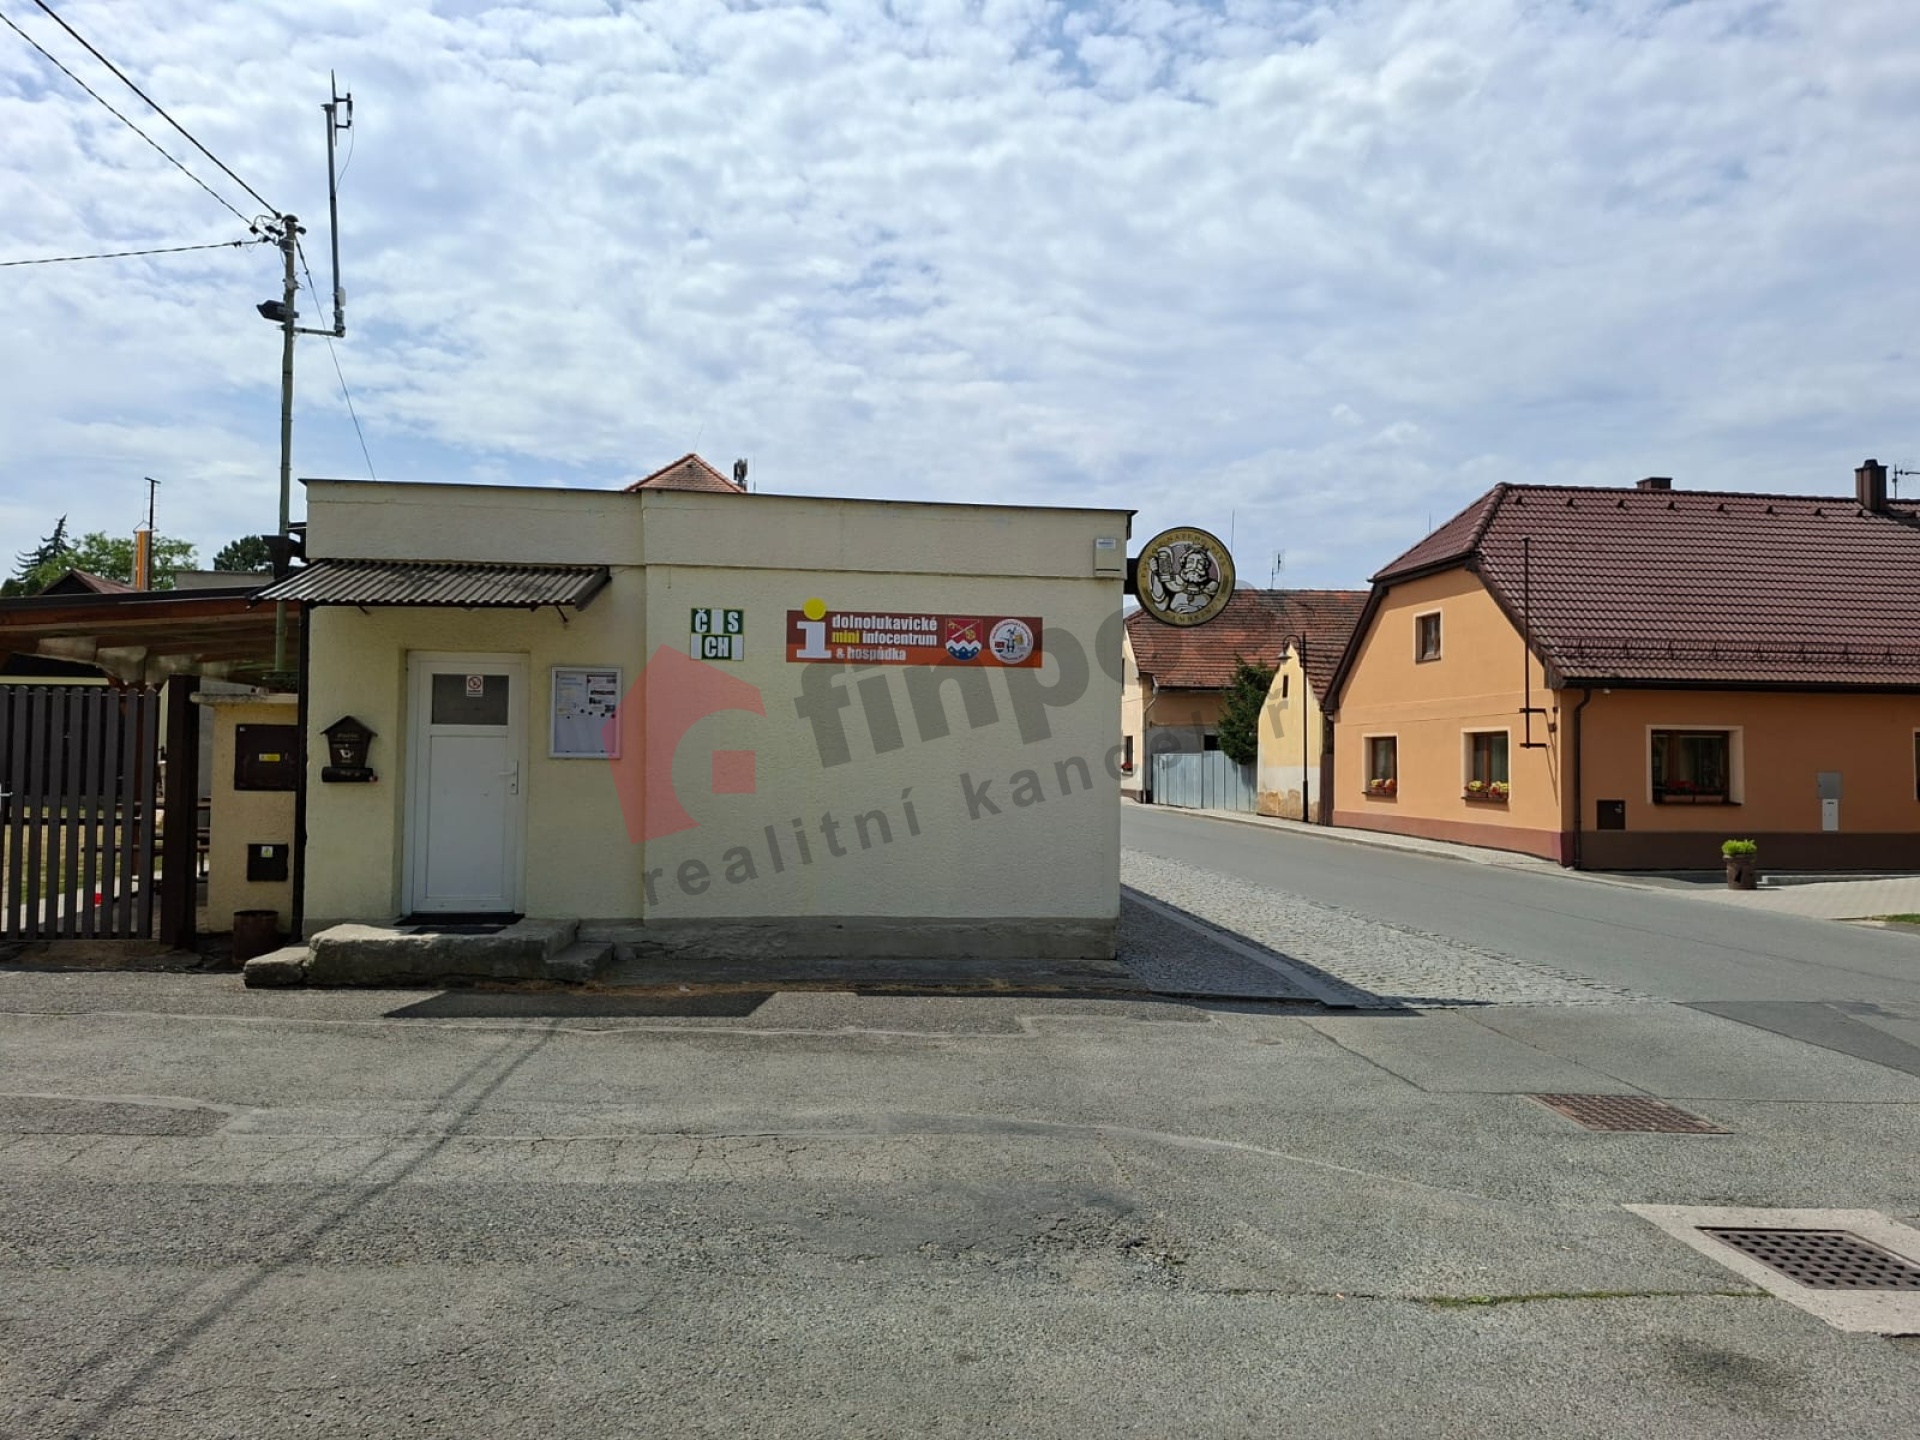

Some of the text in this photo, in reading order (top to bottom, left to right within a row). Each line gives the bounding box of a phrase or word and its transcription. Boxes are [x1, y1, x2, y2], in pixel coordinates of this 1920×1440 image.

[832, 614, 938, 631] dolnolukavické
[831, 630, 938, 646] mini infocentrum
[836, 649, 846, 660] &
